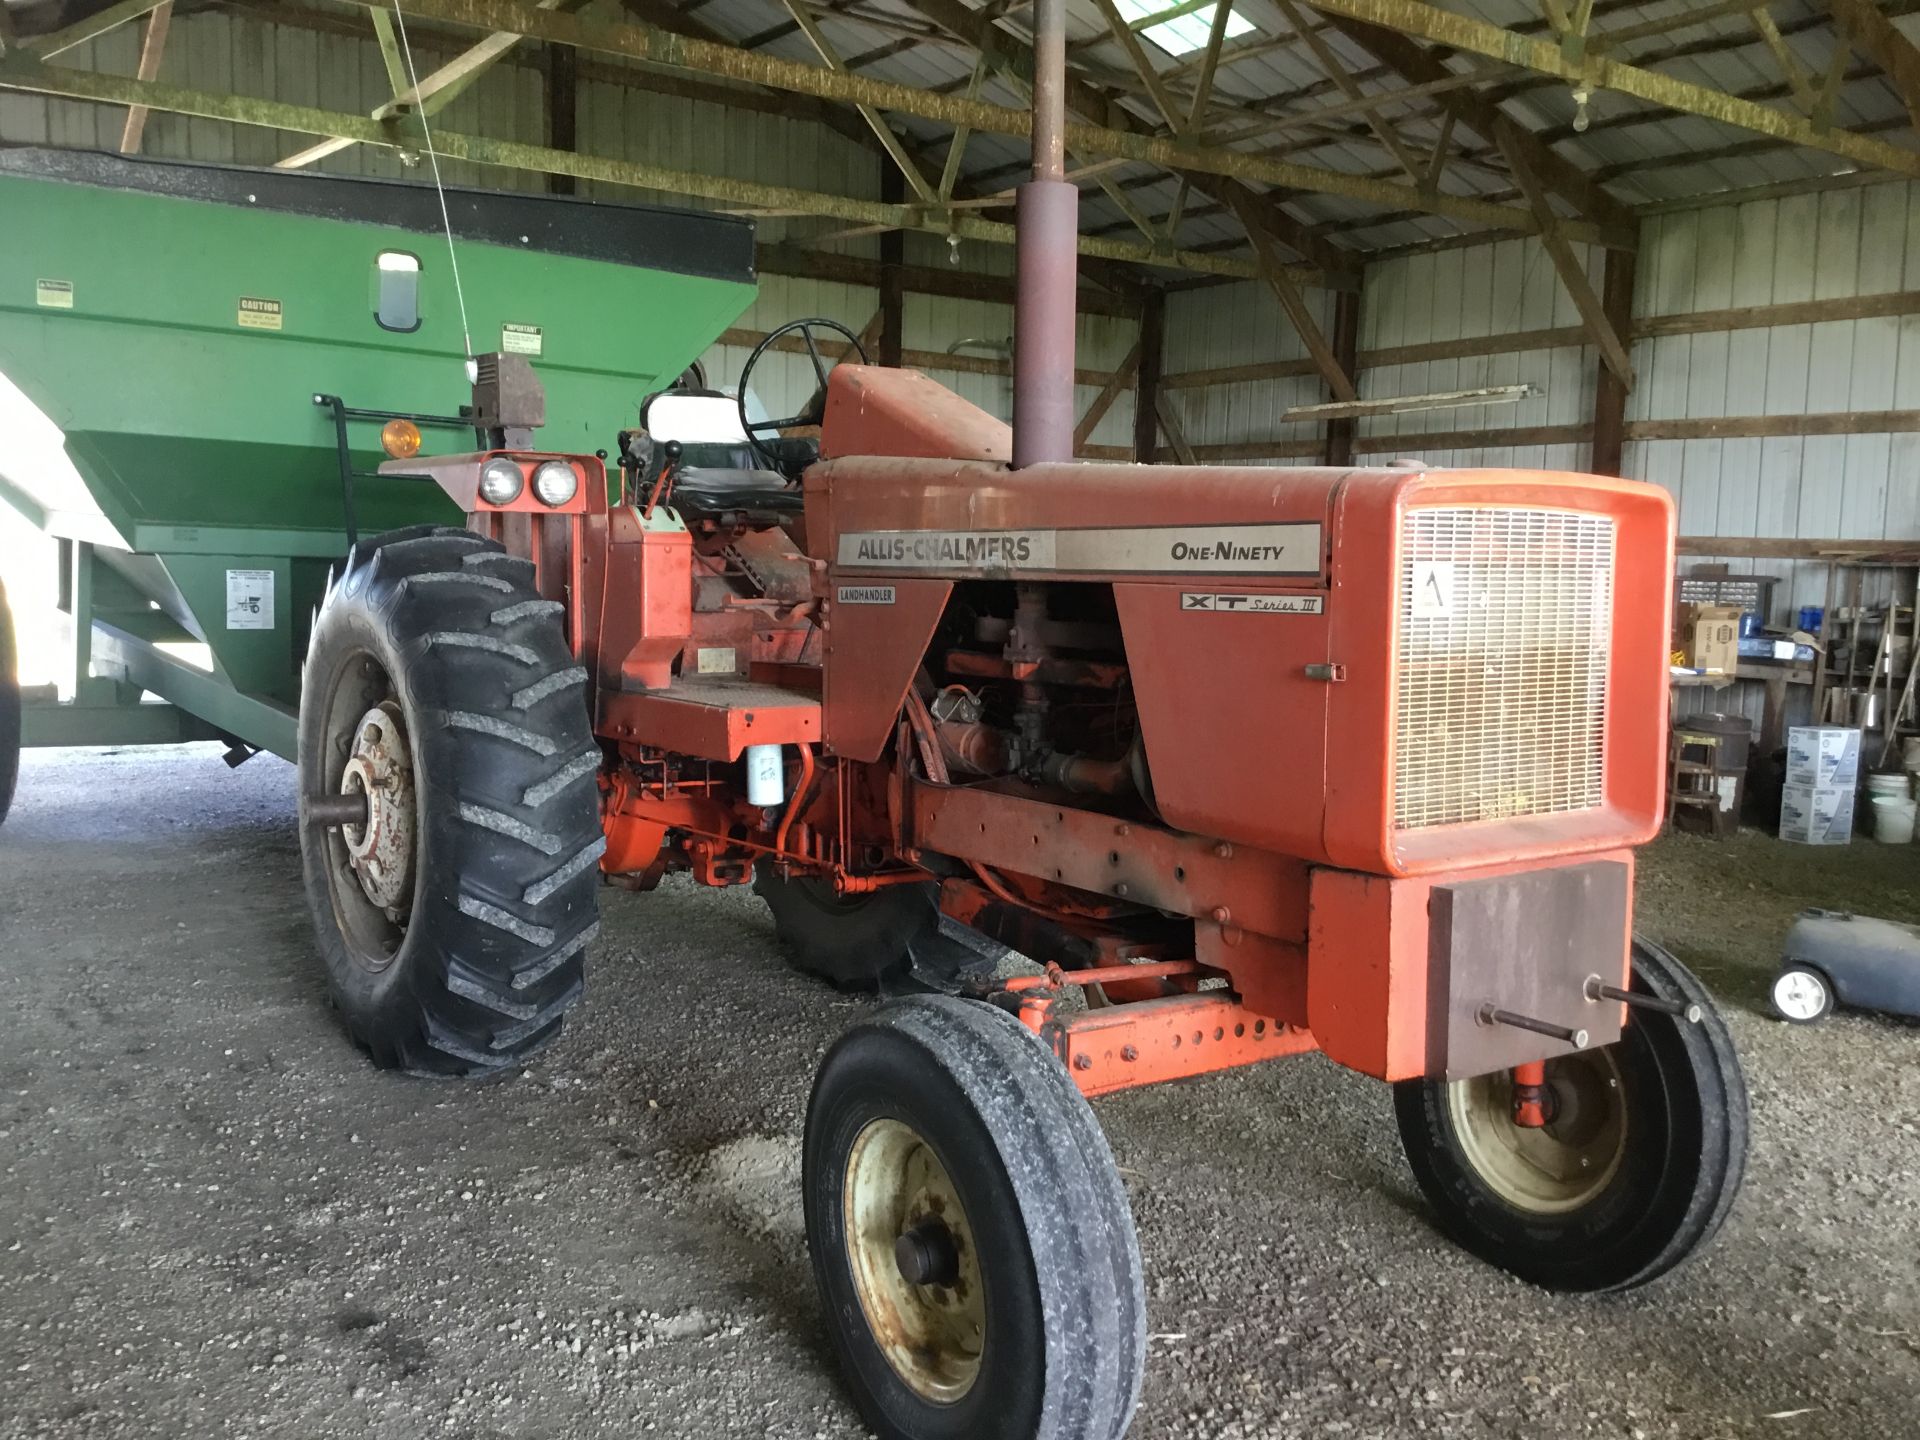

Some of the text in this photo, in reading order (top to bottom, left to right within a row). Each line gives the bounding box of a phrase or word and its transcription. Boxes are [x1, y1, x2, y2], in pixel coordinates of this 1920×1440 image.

[241, 300, 279, 312] CAUTION
[506, 324, 537, 334] IMPORTANT
[857, 536, 1031, 561] ALLIS-CHALMERS
[840, 588, 893, 602] LANDHANDLER
[1249, 599, 1298, 611] Series
[1300, 599, 1317, 612] III
